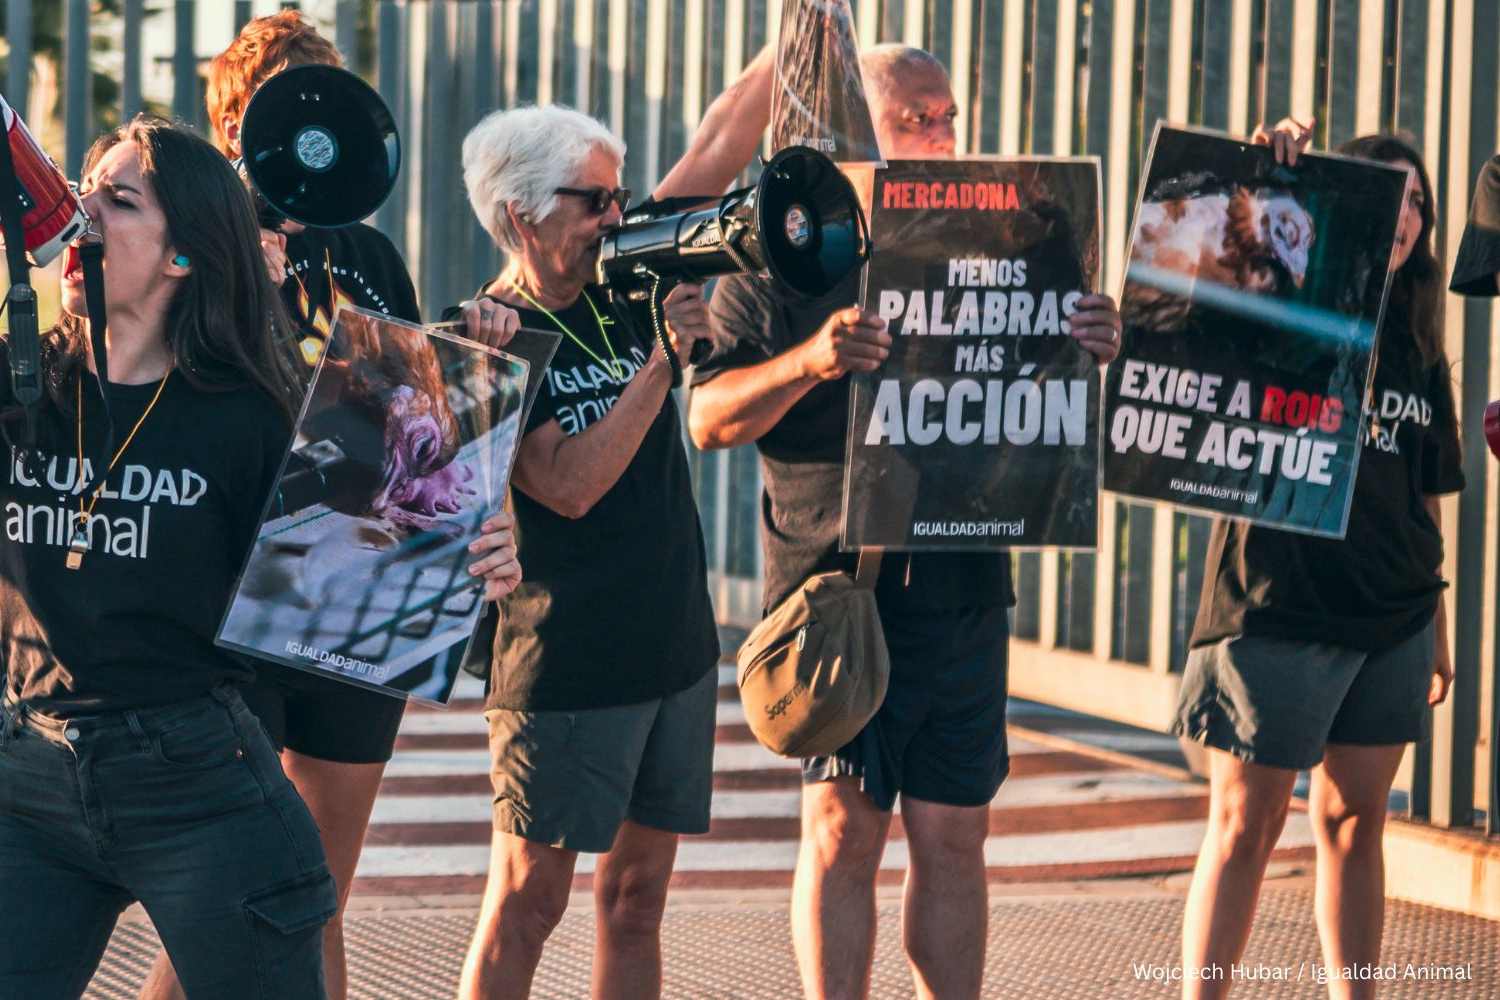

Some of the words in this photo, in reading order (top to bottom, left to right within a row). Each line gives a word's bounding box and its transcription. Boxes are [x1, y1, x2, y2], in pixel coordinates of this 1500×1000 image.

[883, 181, 1020, 211] MERCADONA
[947, 258, 1027, 288] MENOS
[955, 340, 1004, 373] MÁS
[864, 363, 1088, 446] ACCIÓN
[1119, 359, 1222, 414] EXIGE
[1226, 379, 1251, 419] A
[1260, 386, 1345, 434] ROIG
[1110, 405, 1192, 459] QUE
[1196, 426, 1338, 486] ACTÚE
[1170, 478, 1258, 505] IGUALDADanimal
[5, 496, 150, 559] animal
[913, 518, 1024, 537] IGUALDADanimal
[285, 640, 390, 680] IGUALDADanimal
